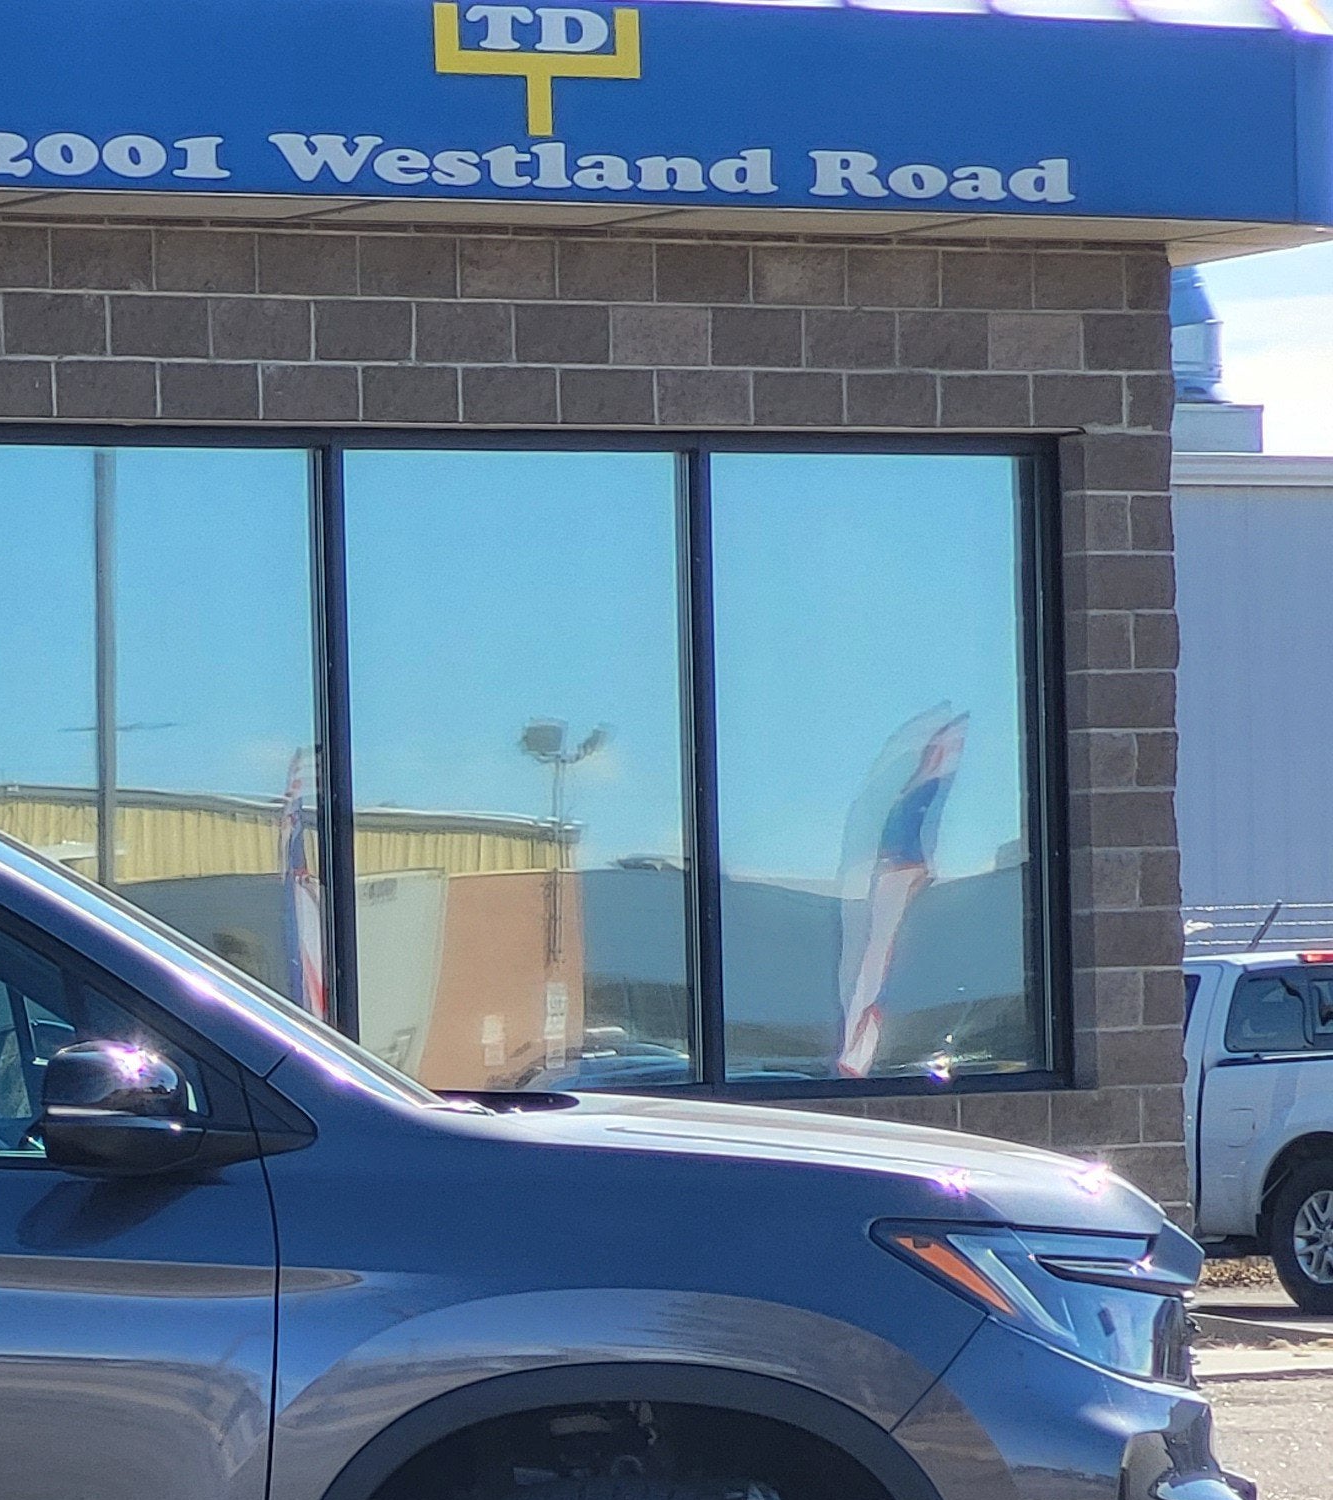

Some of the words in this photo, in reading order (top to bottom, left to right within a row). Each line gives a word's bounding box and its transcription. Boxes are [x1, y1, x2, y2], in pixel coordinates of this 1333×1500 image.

[466, 5, 609, 52] TD
[268, 132, 777, 196] Westland
[808, 149, 1075, 204] Road
